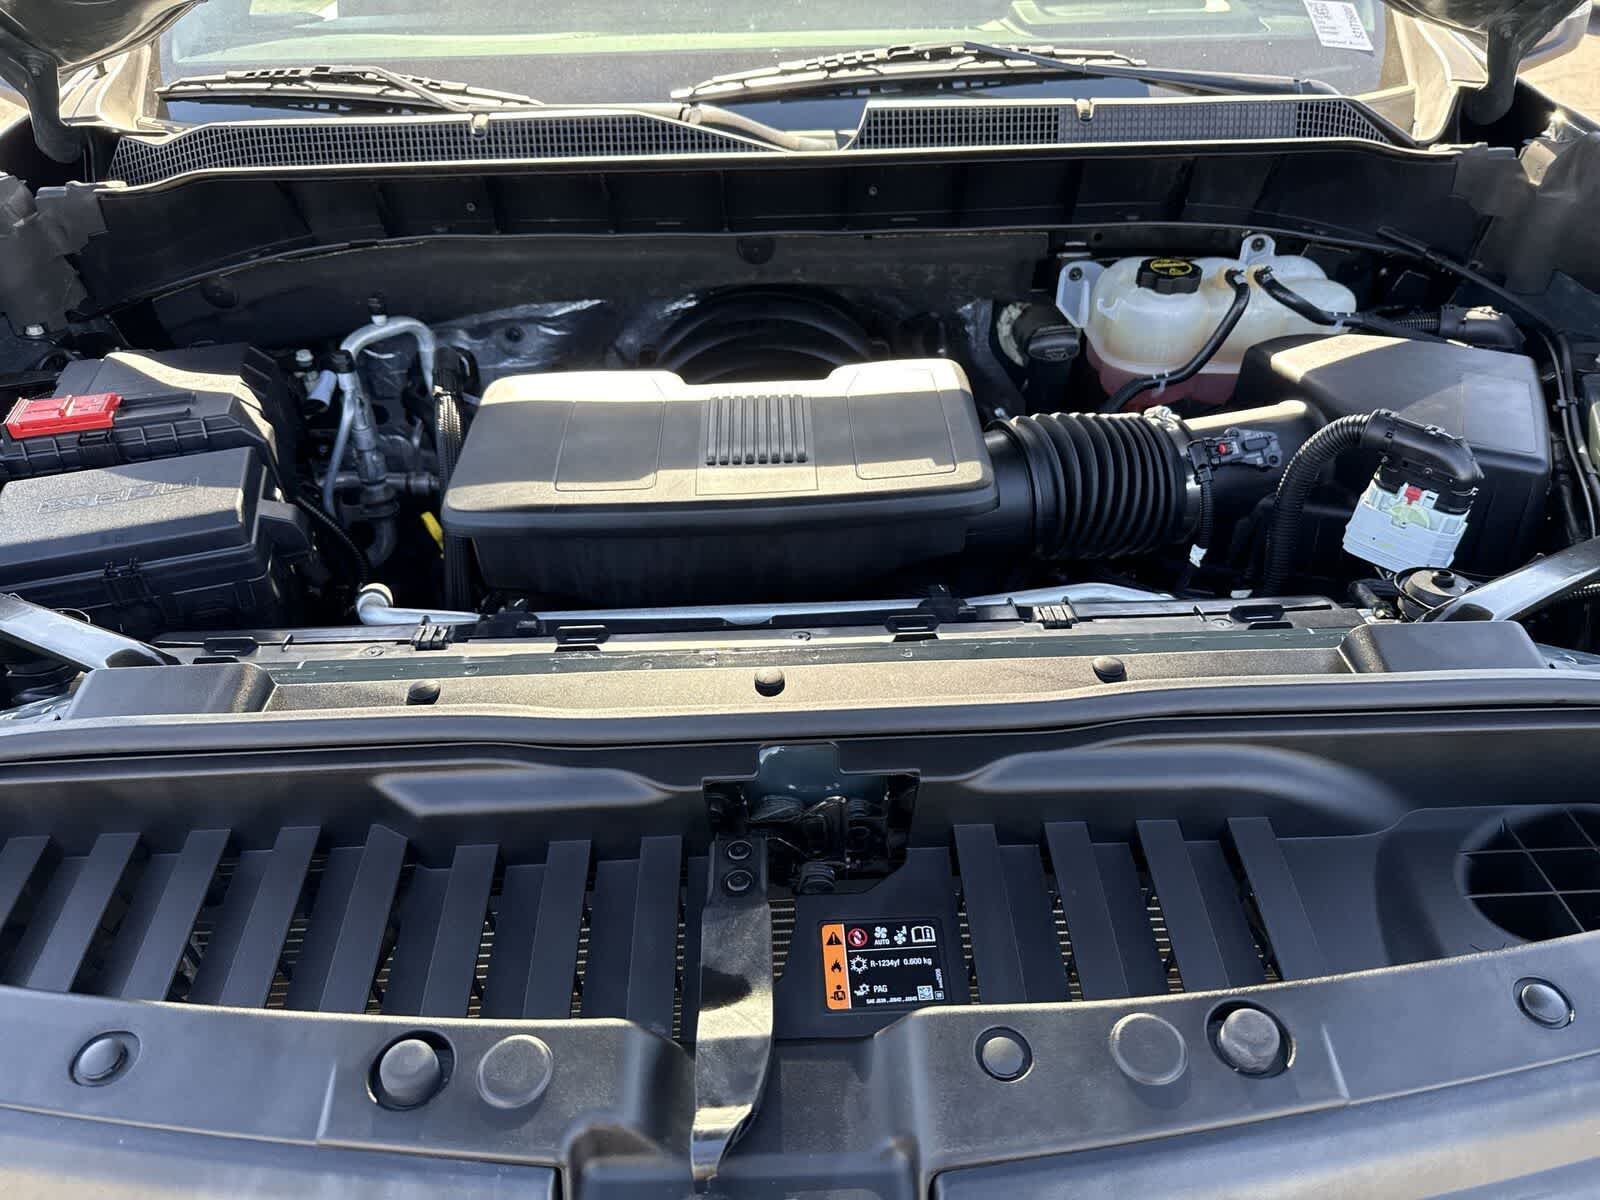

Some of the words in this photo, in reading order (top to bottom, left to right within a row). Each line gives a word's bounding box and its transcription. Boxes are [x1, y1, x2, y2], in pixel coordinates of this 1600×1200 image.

[870, 959, 900, 968] R-1234yf
[923, 957, 932, 966] kg
[873, 984, 888, 993] PAG
